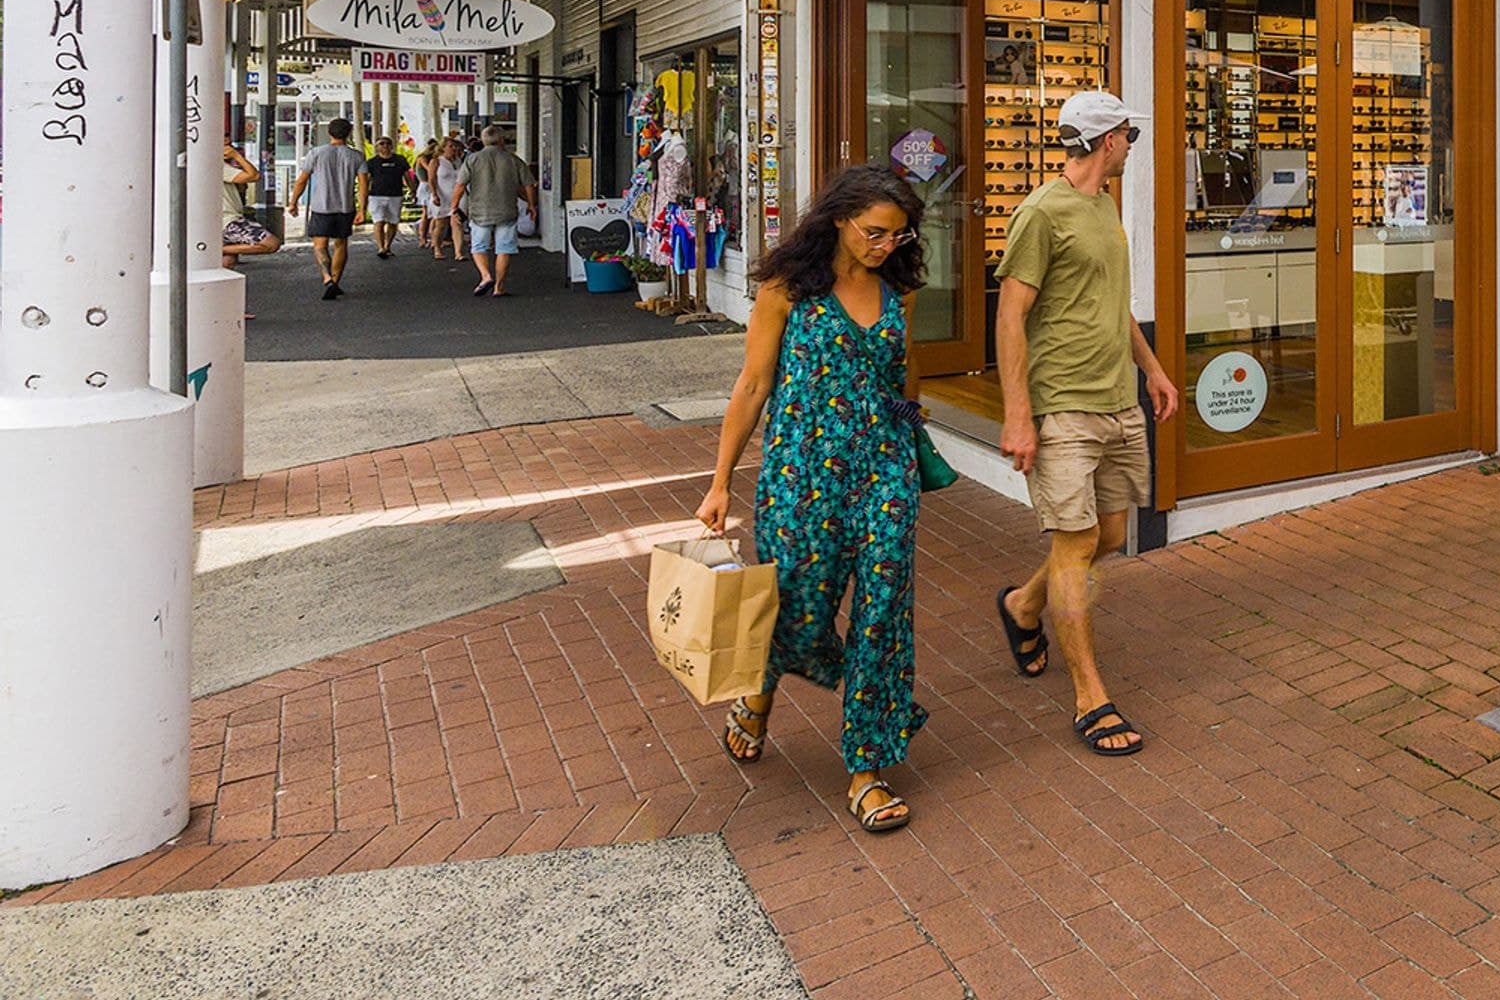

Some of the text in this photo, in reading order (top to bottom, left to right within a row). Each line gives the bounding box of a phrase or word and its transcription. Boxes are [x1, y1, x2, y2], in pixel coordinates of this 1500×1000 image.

[360, 51, 409, 71] DRAG
[437, 52, 477, 73] DINE
[903, 141, 935, 153] 50%
[903, 154, 933, 166] OFF
